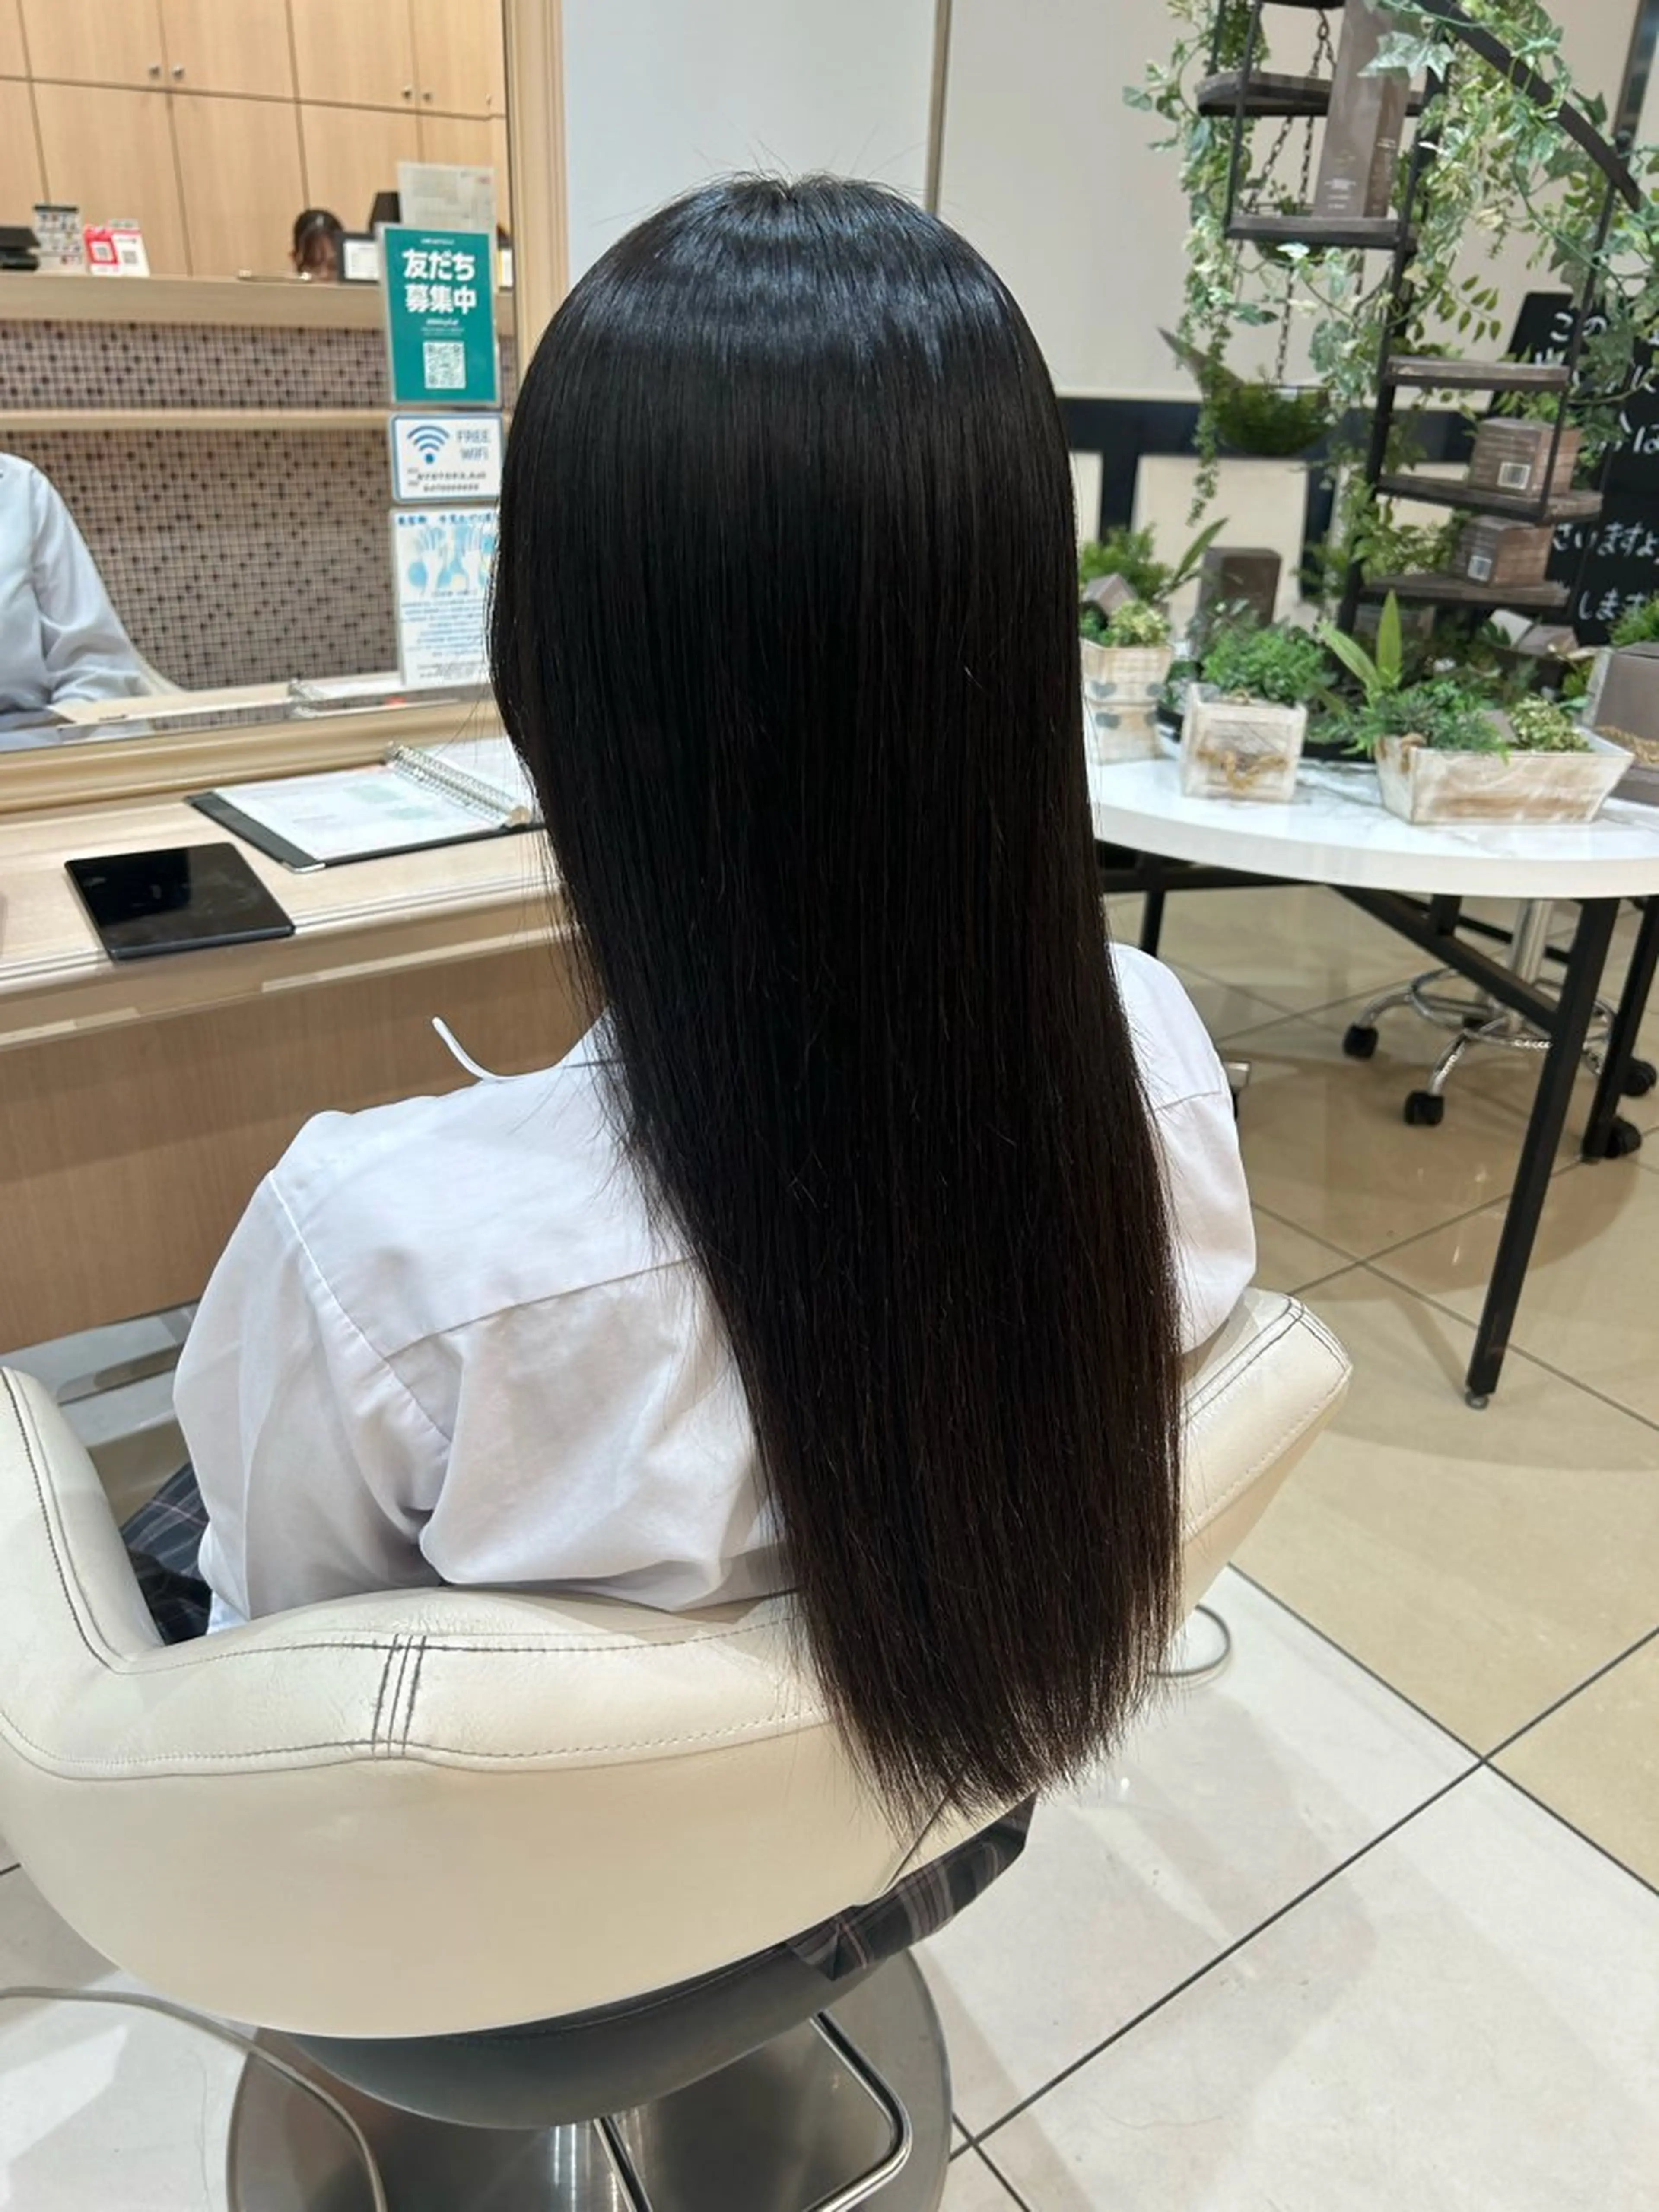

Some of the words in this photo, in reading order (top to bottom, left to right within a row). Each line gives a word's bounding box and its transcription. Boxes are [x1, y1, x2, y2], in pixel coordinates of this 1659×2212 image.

[402, 248, 476, 281] 友だち
[405, 283, 477, 315] 募集中
[457, 429, 490, 443] FREE
